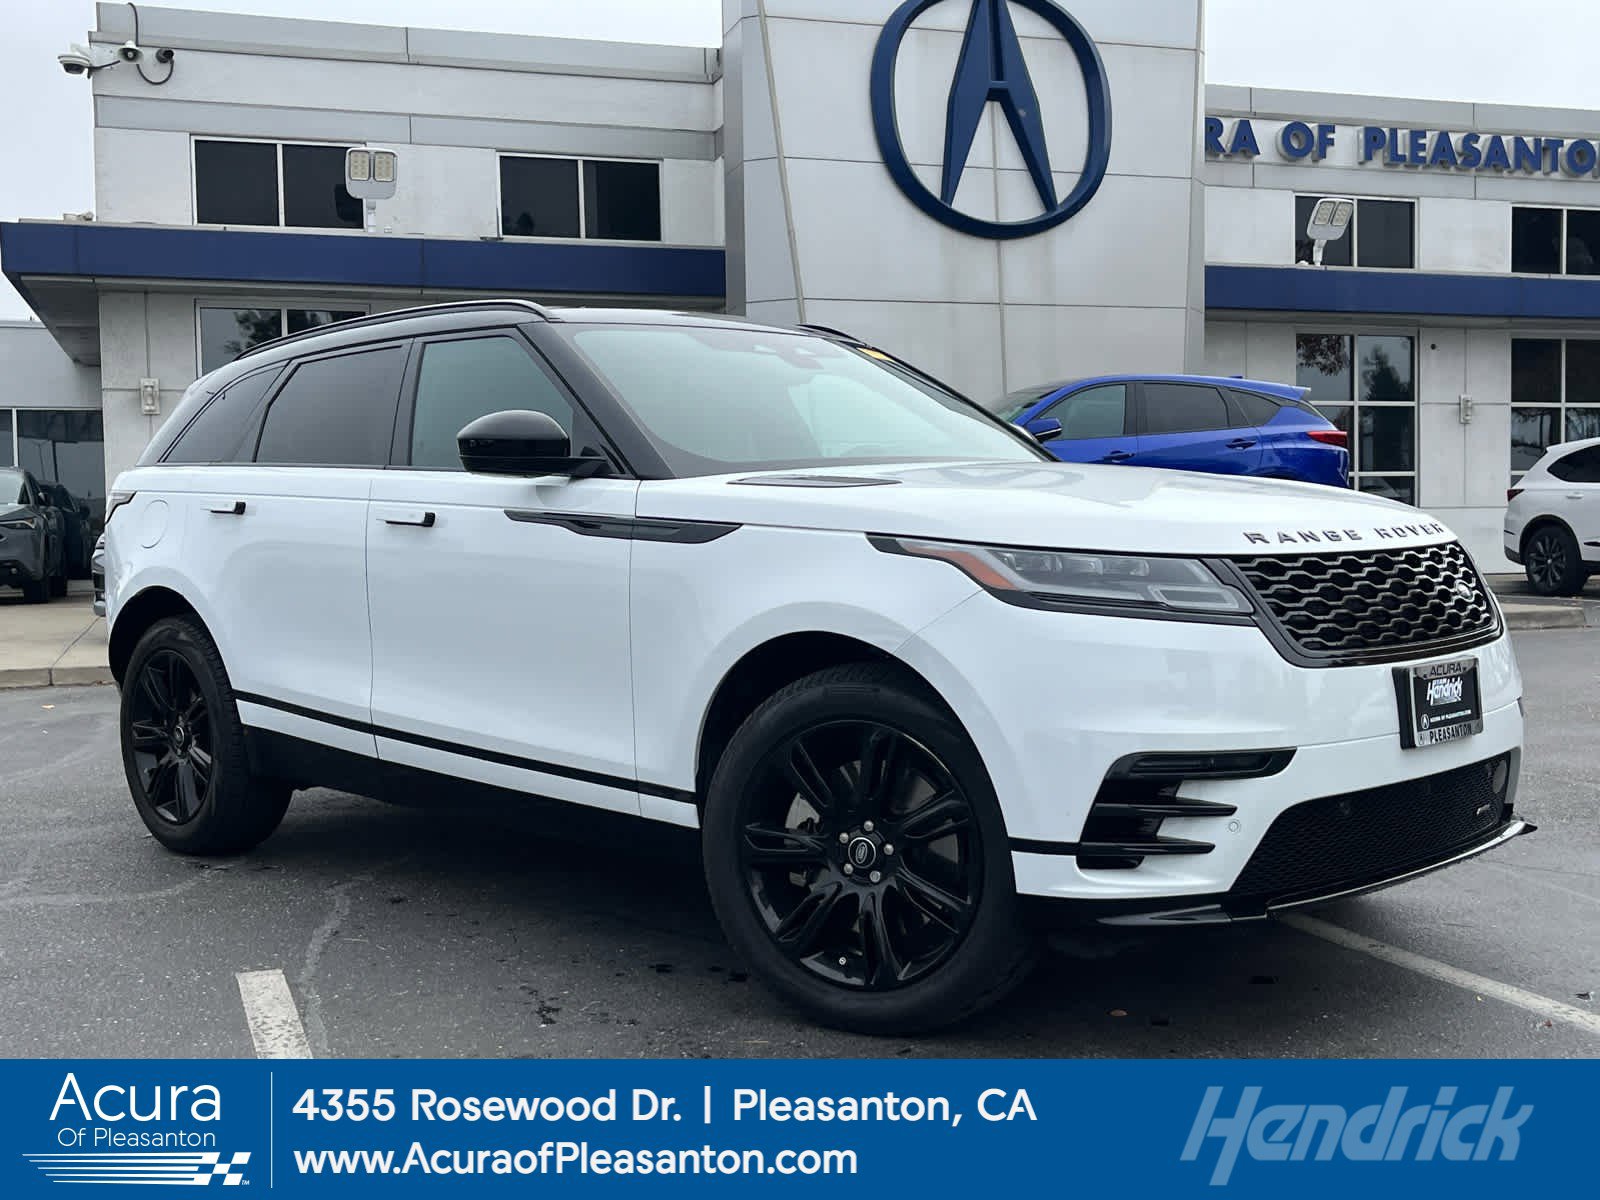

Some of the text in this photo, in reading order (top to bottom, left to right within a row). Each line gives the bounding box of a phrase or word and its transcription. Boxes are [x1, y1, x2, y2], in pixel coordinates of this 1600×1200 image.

[1279, 121, 1335, 160] OF
[1360, 126, 1600, 177] PLEASANTO
[1242, 522, 1444, 545] RANGE ROVER
[1429, 662, 1462, 677] ACURA
[1426, 676, 1463, 706] Hendrick
[1429, 722, 1472, 744] PLEASANTON
